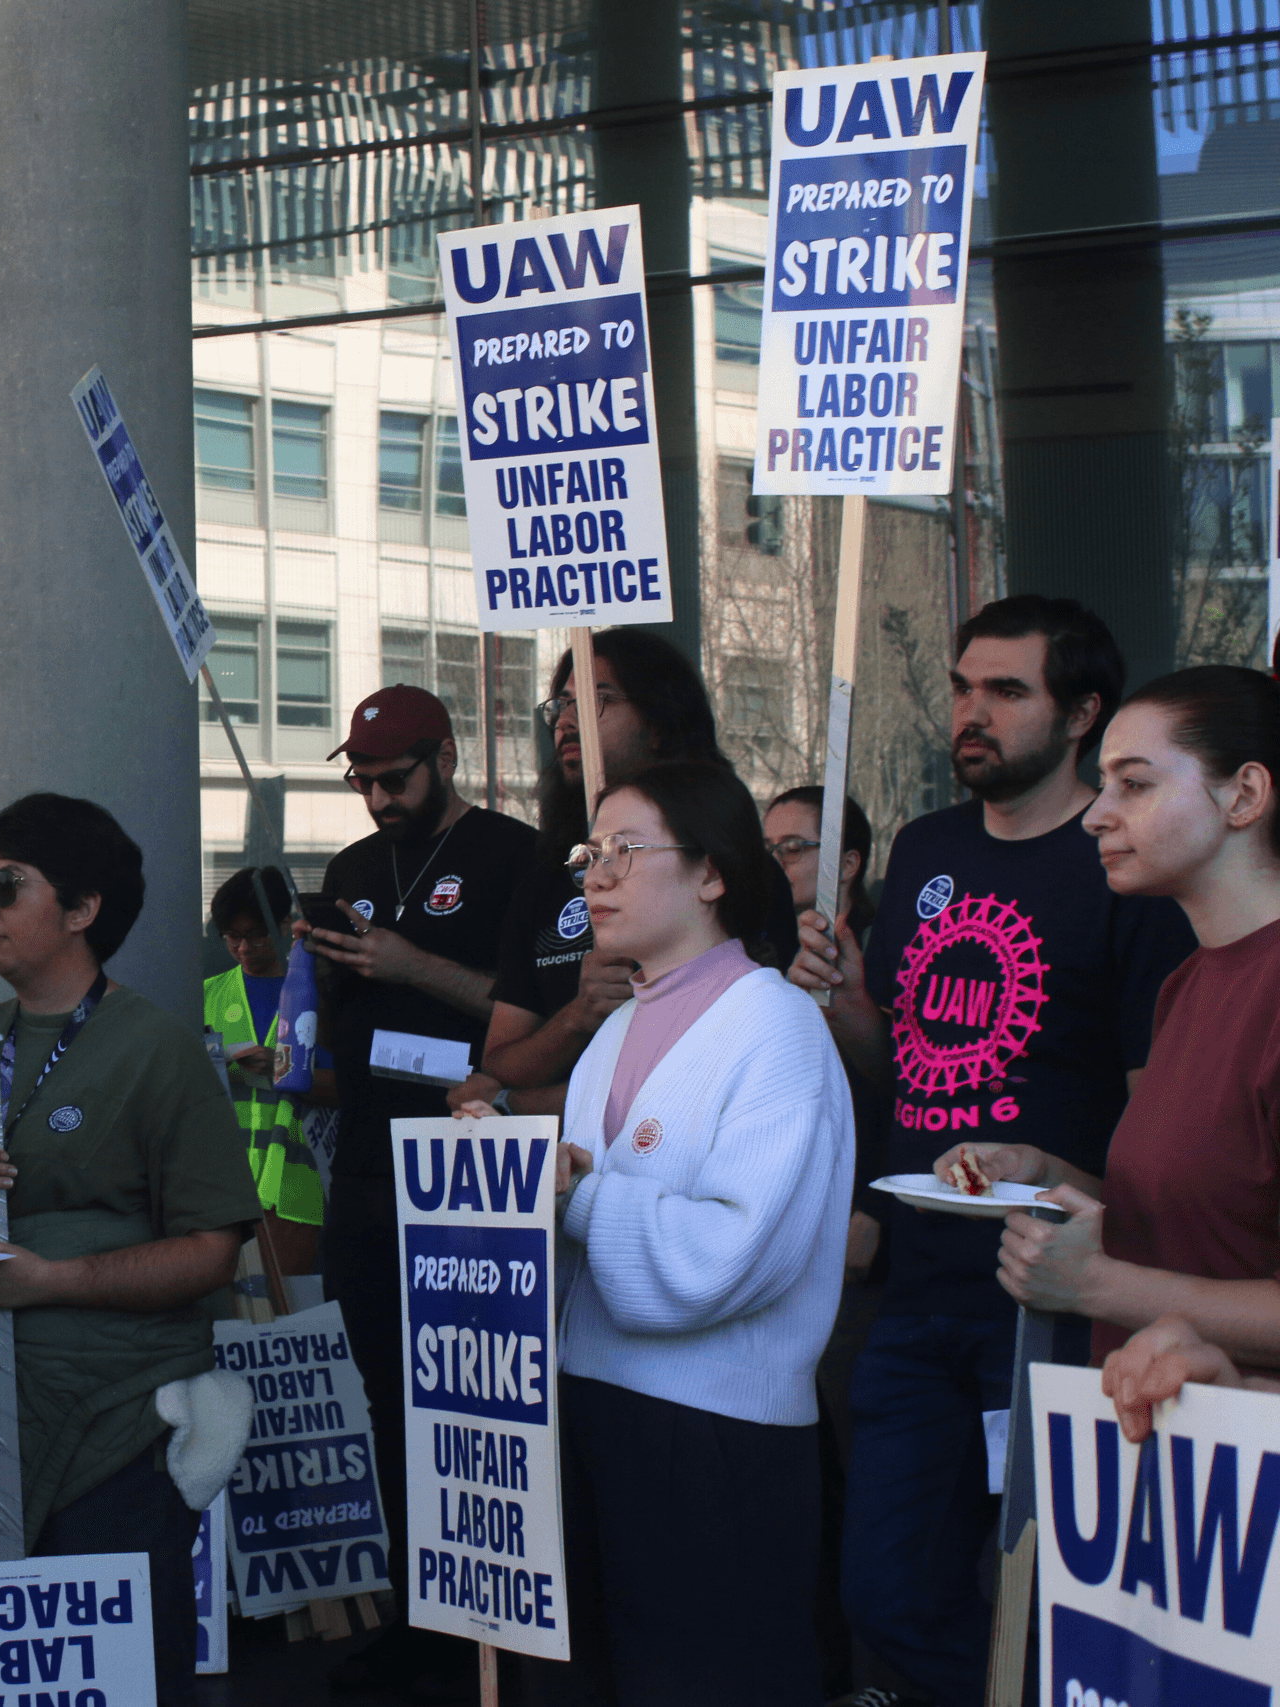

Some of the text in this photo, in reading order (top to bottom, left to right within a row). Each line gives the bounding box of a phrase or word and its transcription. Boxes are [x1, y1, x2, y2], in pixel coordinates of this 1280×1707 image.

[784, 71, 974, 147] UAW
[786, 173, 954, 213] PREPARED TO
[450, 223, 630, 304] UAW
[778, 232, 954, 297] STRIKE
[473, 319, 635, 367] PREPARED TO
[794, 316, 929, 366] UNFAIR
[472, 376, 640, 446] STRIKE
[797, 371, 919, 418] LABOR
[767, 424, 943, 472] PRACTICE
[496, 457, 629, 510] UNFAIR
[507, 509, 626, 559] LABOR
[486, 557, 661, 611] PRACTICE
[560, 911, 589, 929] STRIKE
[920, 890, 948, 908] STRIKE
[921, 974, 998, 1029] UAW
[989, 1096, 1021, 1123] 6
[402, 1138, 549, 1214] UAW
[414, 1254, 536, 1297] PREPARED TO
[213, 1332, 349, 1372] PRACTICE
[415, 1322, 543, 1406] STRIKE
[233, 1444, 367, 1494] STRIKE
[433, 1422, 529, 1492] UNFAIR
[241, 1500, 372, 1536] PREPARED TO
[440, 1486, 525, 1558] LABOR
[1048, 1411, 1280, 1640] UAW
[245, 1540, 389, 1598] UAW
[419, 1546, 556, 1630] PRACTICE
